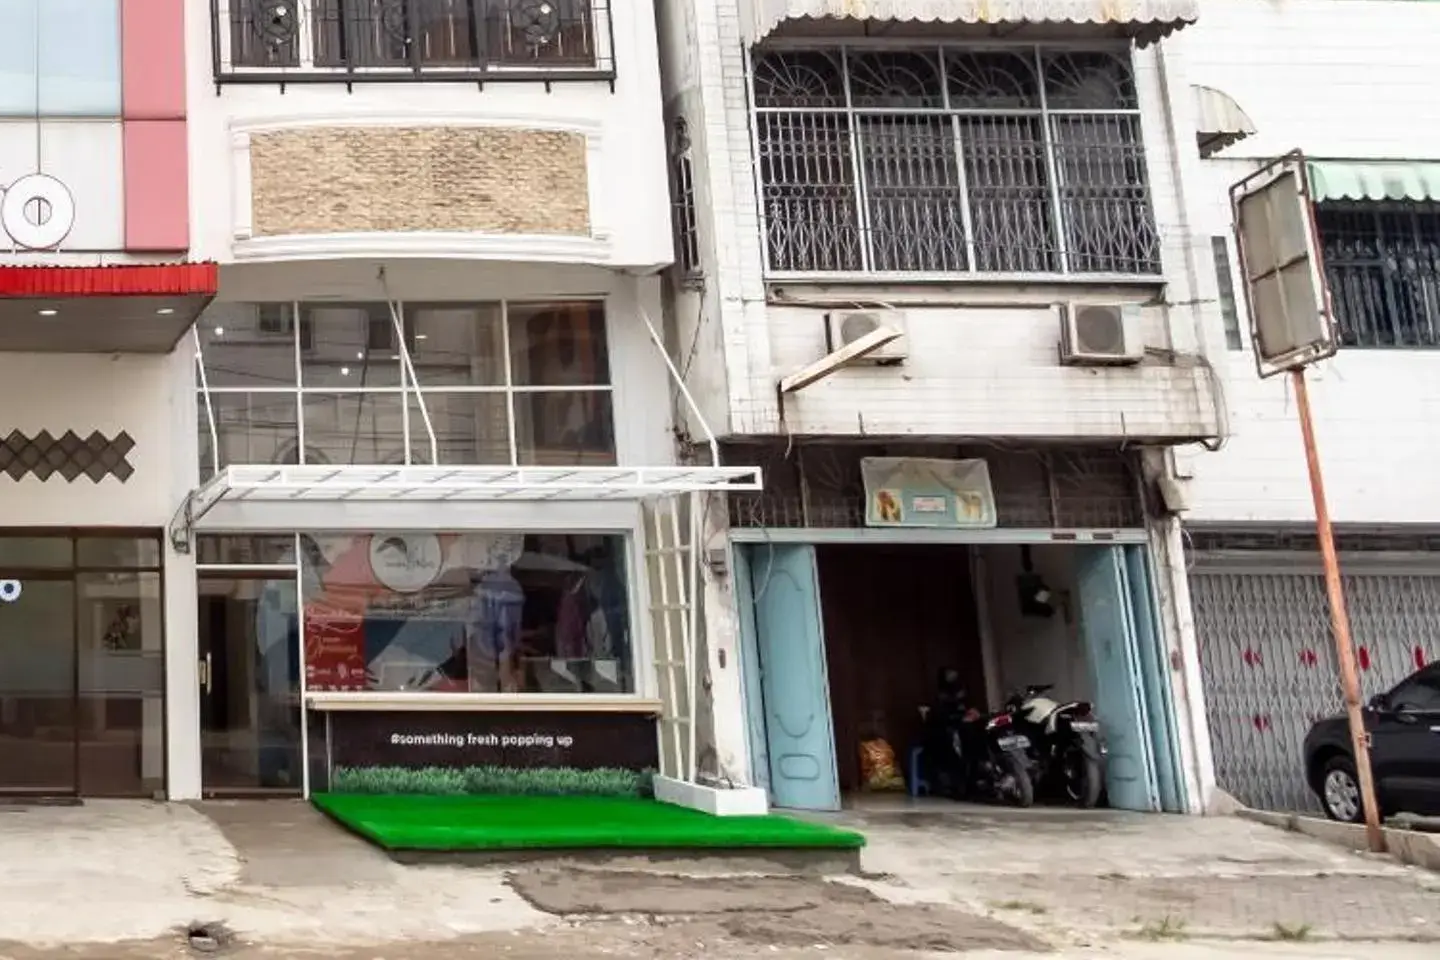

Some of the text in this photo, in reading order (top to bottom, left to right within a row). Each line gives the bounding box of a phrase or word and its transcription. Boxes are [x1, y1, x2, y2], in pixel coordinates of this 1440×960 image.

[391, 733, 573, 747] #something fresh popping up
